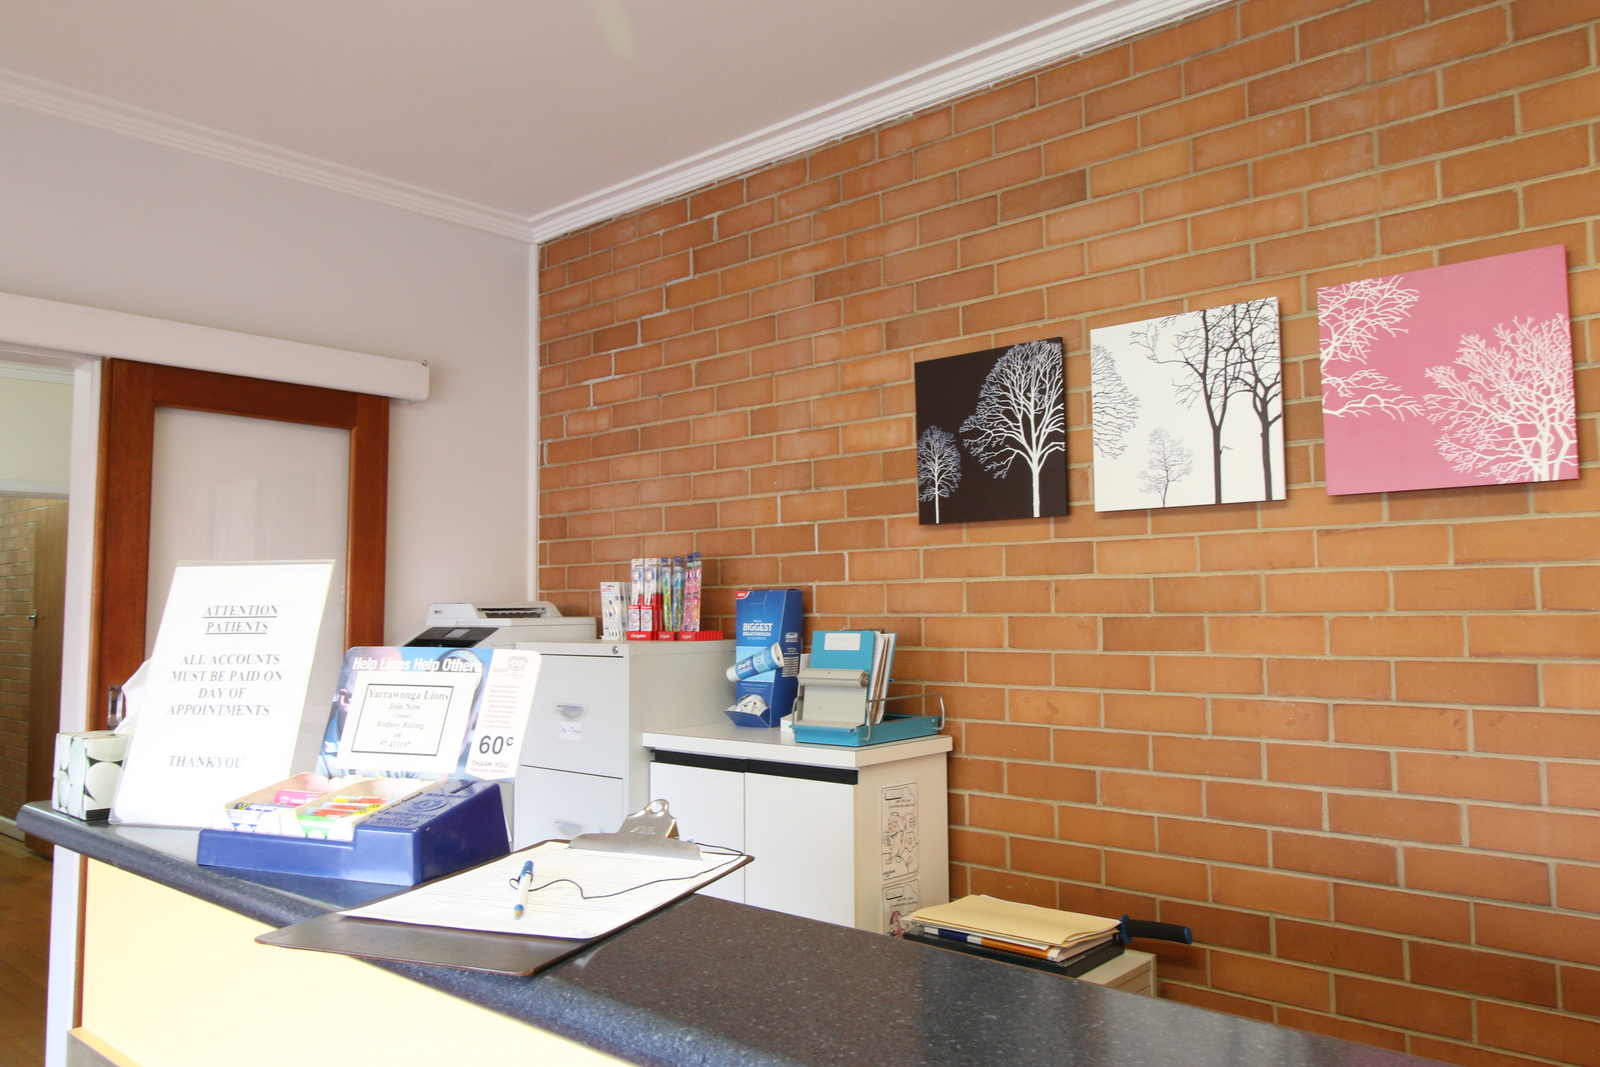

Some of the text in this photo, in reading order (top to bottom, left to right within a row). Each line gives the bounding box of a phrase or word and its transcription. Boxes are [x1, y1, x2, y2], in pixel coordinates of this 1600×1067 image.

[204, 605, 279, 616] ATTENTION
[206, 621, 269, 632] PATIENTS
[742, 622, 774, 632] BIGGEST
[180, 654, 280, 665] ALL ACCOUNTS
[352, 656, 483, 673] Help Lions Help Others
[170, 670, 284, 682] MUST BE PAID ON
[198, 688, 247, 698] DAY OF
[369, 689, 450, 702] Yarrawonga Lions
[166, 704, 270, 716] APPOINTMENTS
[388, 702, 404, 710] Join
[376, 720, 400, 730] Rodney
[168, 755, 244, 768] THANKYOU
